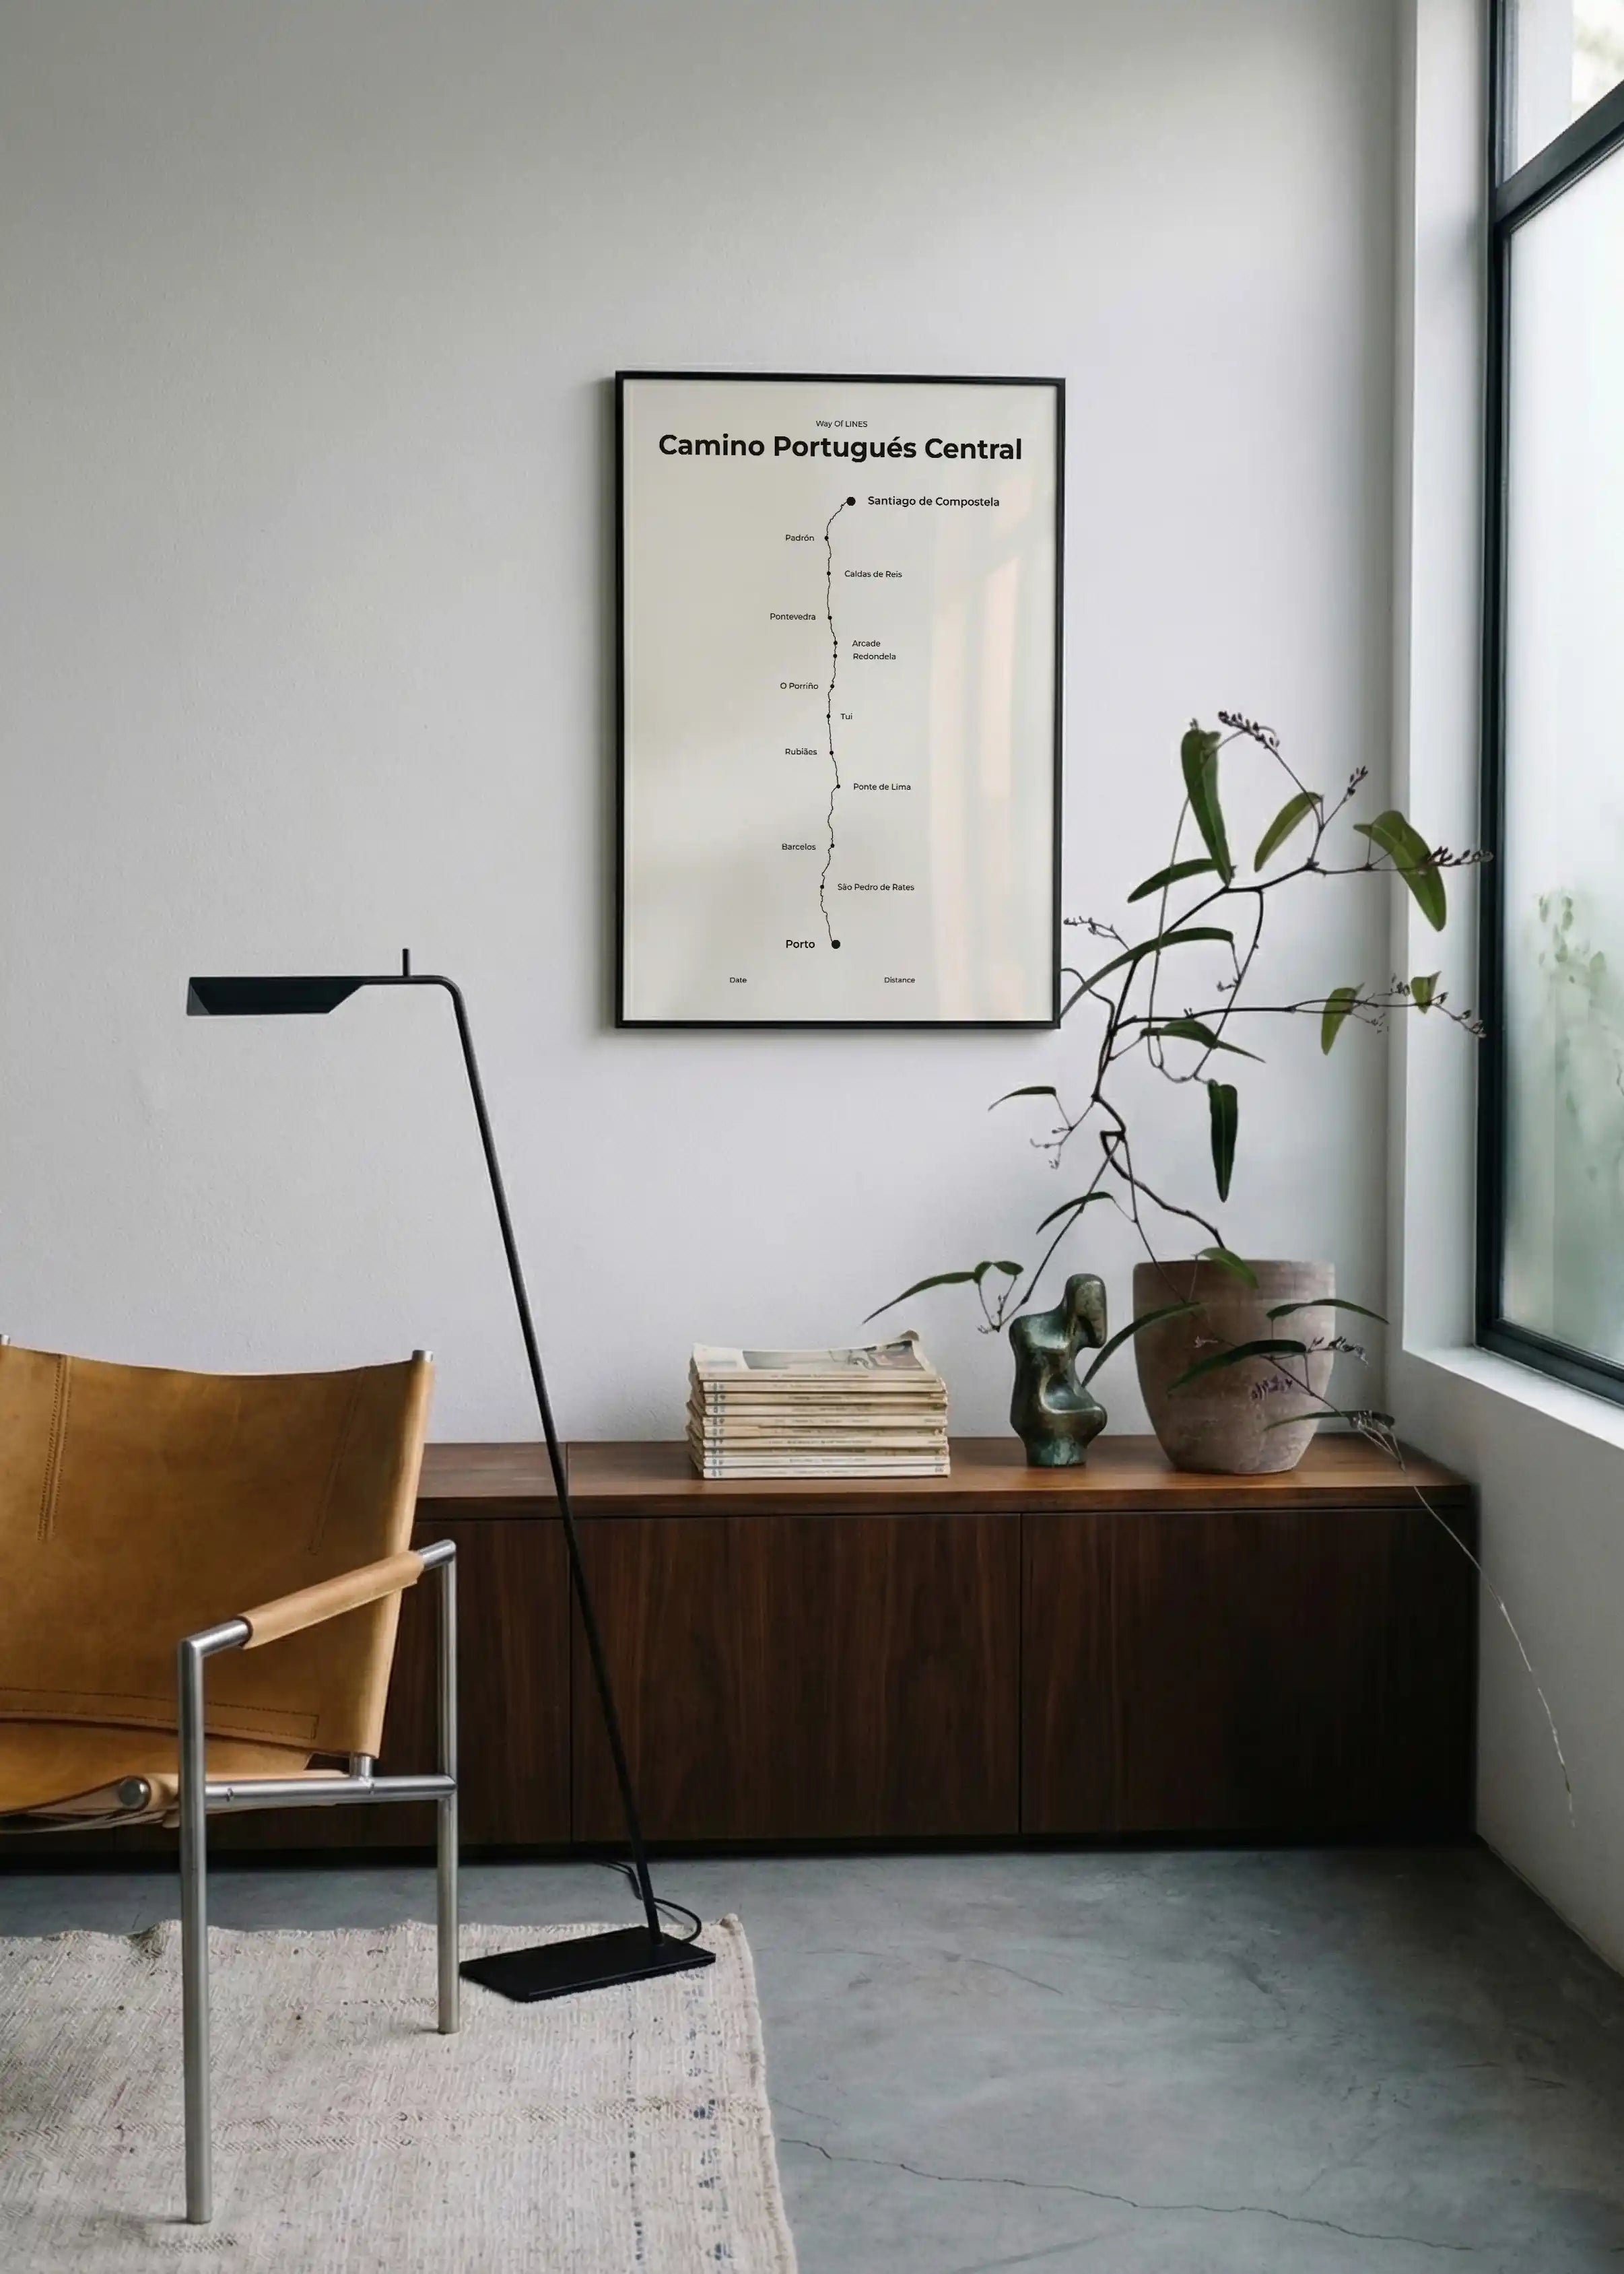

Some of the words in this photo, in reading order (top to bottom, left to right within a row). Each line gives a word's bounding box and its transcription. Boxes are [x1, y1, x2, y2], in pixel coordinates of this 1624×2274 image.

[815, 420, 833, 428] Way
[834, 420, 844, 428] Of
[658, 433, 766, 457] Camino
[774, 436, 917, 463] Portugués
[924, 438, 1022, 460] Central
[867, 496, 916, 508] Santiago
[918, 496, 933, 506] de
[935, 496, 1000, 508] Compostela
[844, 570, 872, 578] Caldas
[770, 613, 816, 621] Pontevedra
[852, 653, 896, 661] Redondela
[780, 681, 787, 690] O
[785, 747, 817, 756] Rubiães
[853, 782, 877, 791] Ponte
[781, 842, 817, 850] Barcelos
[837, 883, 852, 891] São
[854, 883, 879, 891] Pedro
[891, 883, 915, 891] Rates
[786, 939, 815, 949] Porto
[883, 976, 916, 984] Distance
